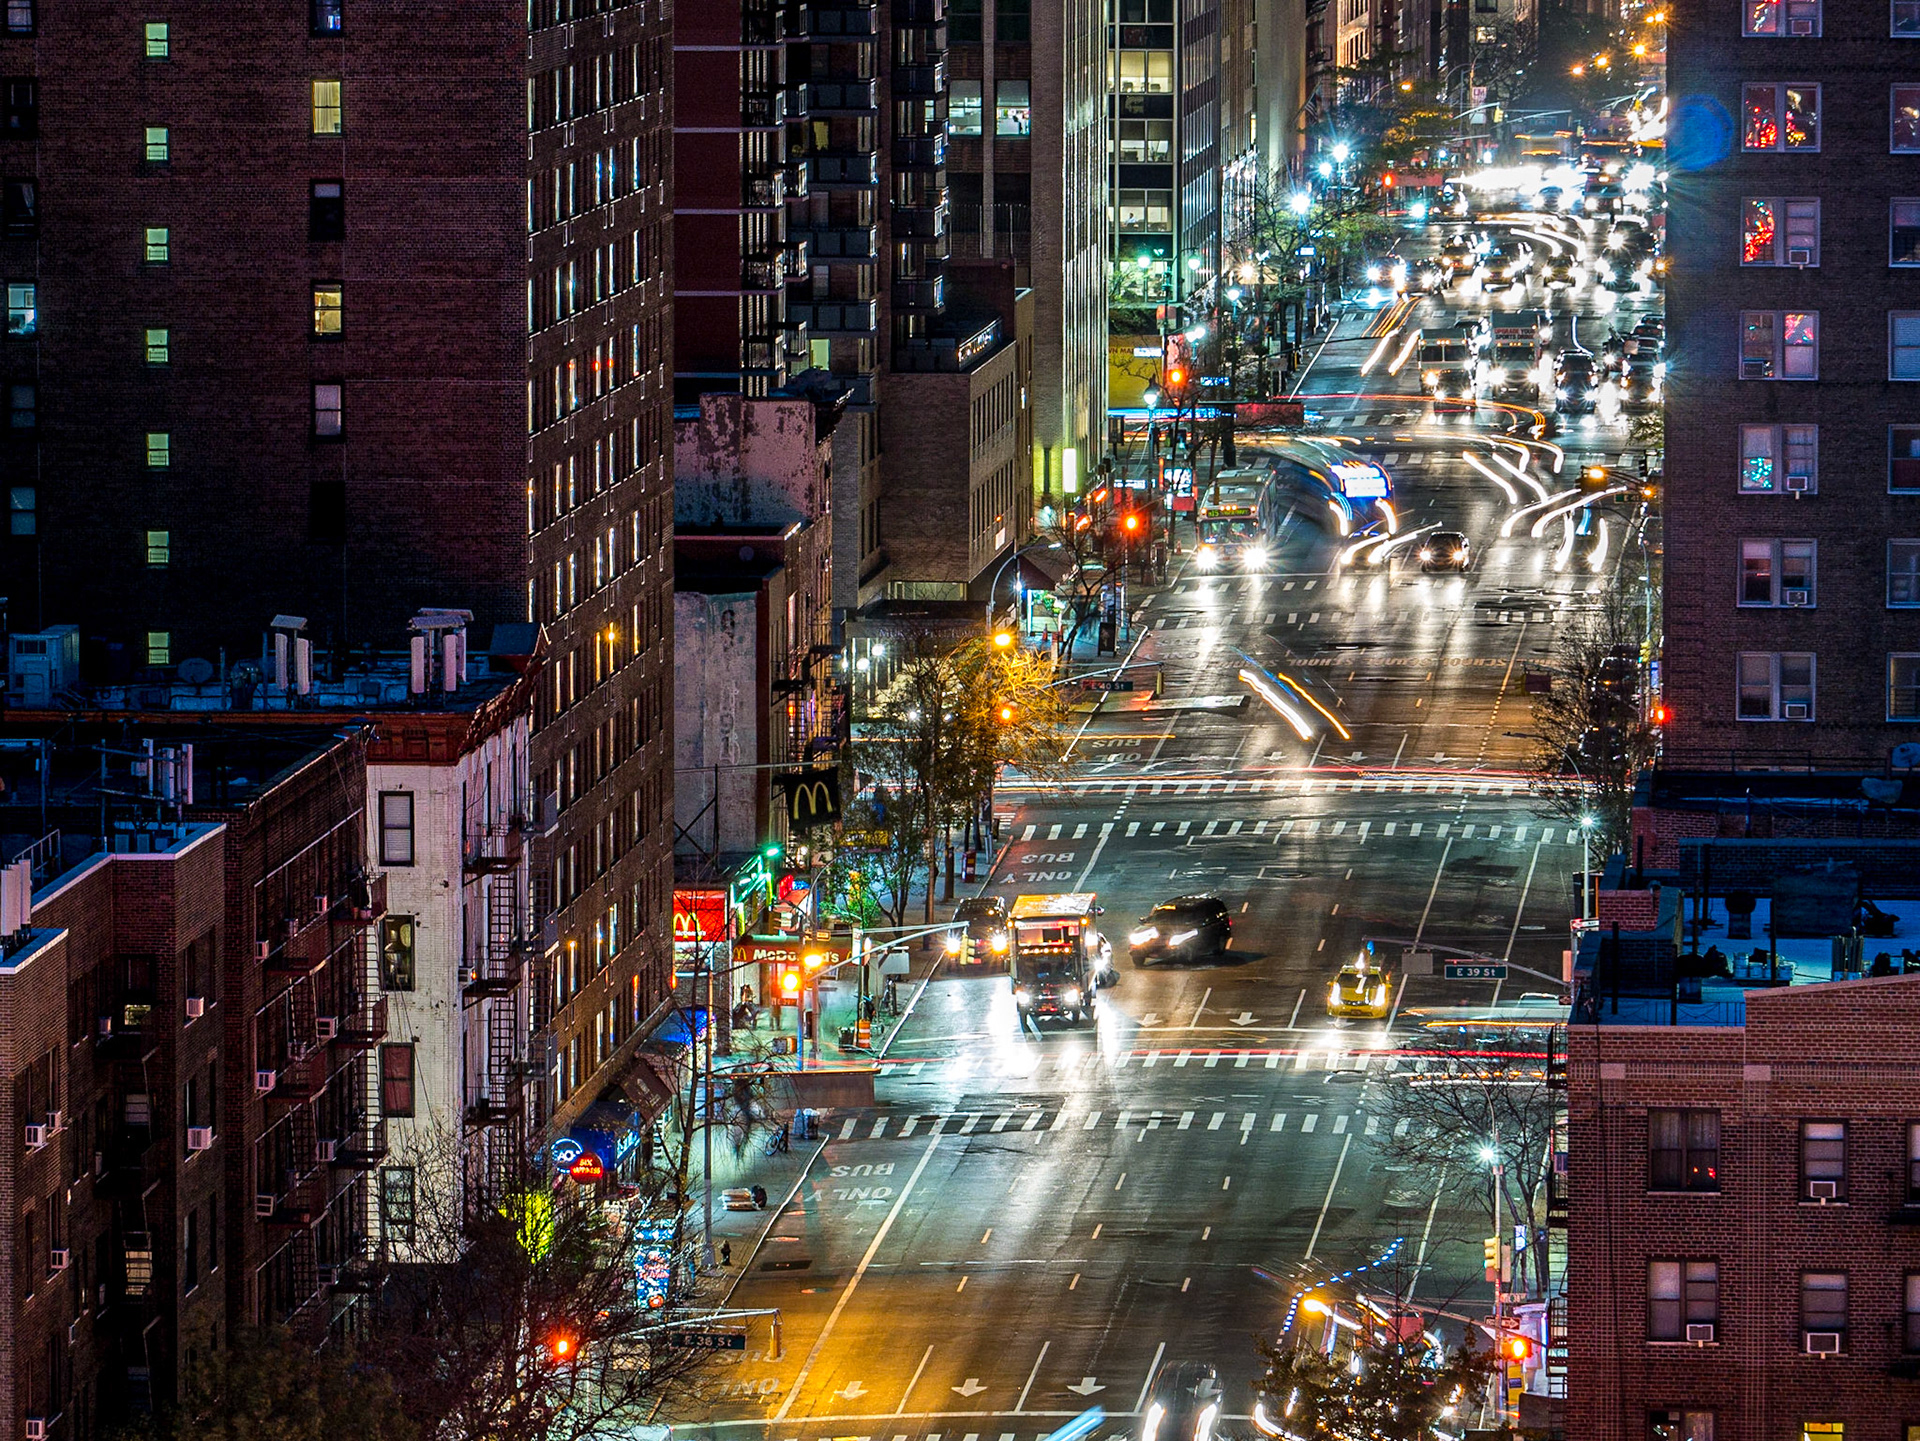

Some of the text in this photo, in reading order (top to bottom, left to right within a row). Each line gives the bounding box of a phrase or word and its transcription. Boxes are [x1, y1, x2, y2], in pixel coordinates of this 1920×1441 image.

[1114, 682, 1124, 690] St
[1091, 738, 1142, 749] BUS
[1021, 852, 1076, 864] BUS
[999, 871, 1073, 884] ONLY
[753, 948, 840, 963] McDod's
[1456, 967, 1496, 977] E 39 St
[579, 1158, 593, 1167] SIX
[829, 1162, 896, 1178] BUS
[803, 1186, 893, 1203] ONLY
[717, 1336, 732, 1348] St
